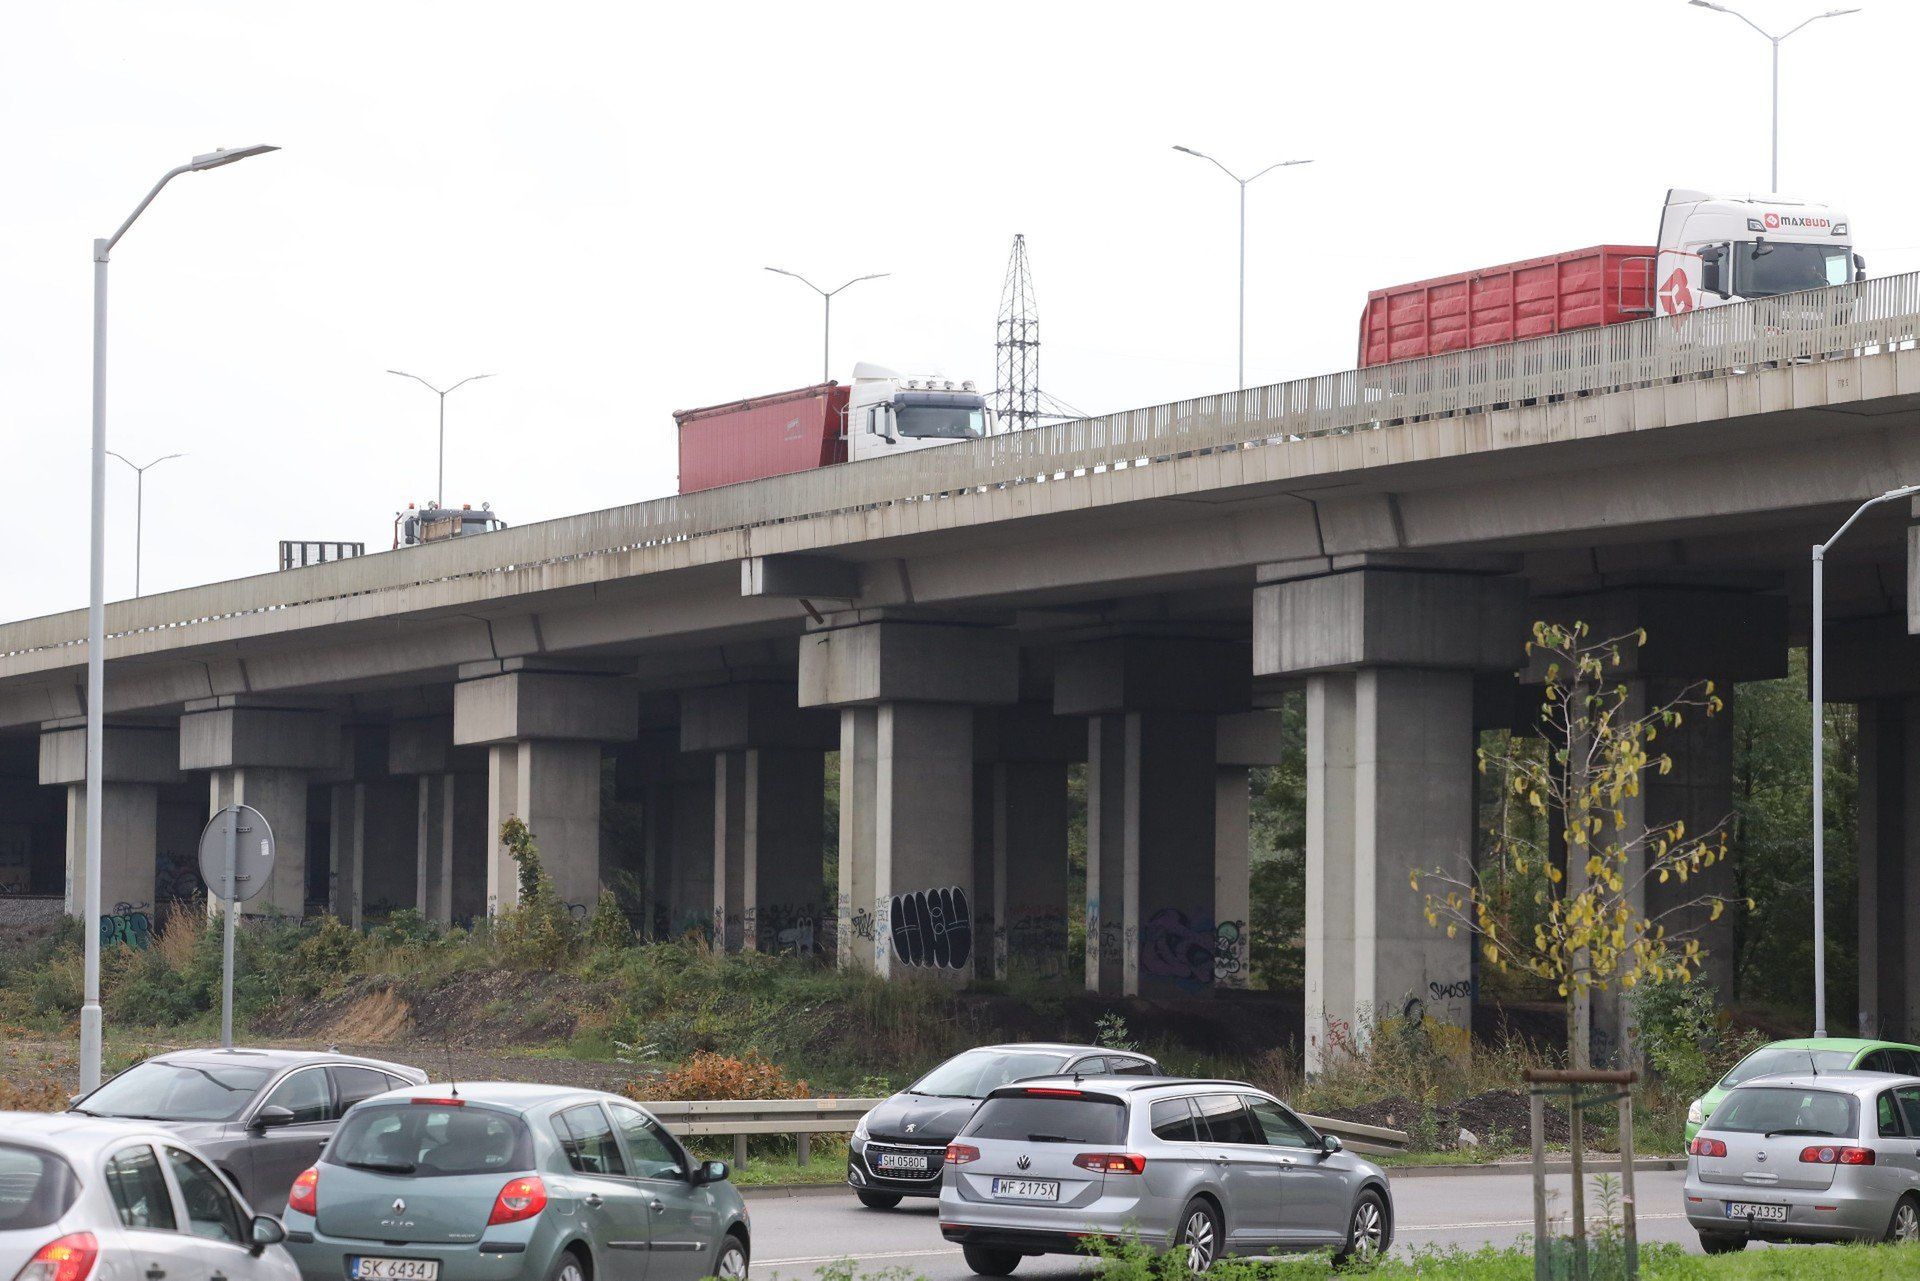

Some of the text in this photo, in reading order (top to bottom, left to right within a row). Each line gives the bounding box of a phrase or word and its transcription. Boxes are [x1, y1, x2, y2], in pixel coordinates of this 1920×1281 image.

[1780, 216, 1831, 228] MAXBUDI
[883, 1154, 926, 1168] SH 0580C
[1000, 1180, 1057, 1197] WF 2175X
[1733, 1204, 1784, 1219] SK 5A335
[361, 1260, 435, 1279] SK 6434J
